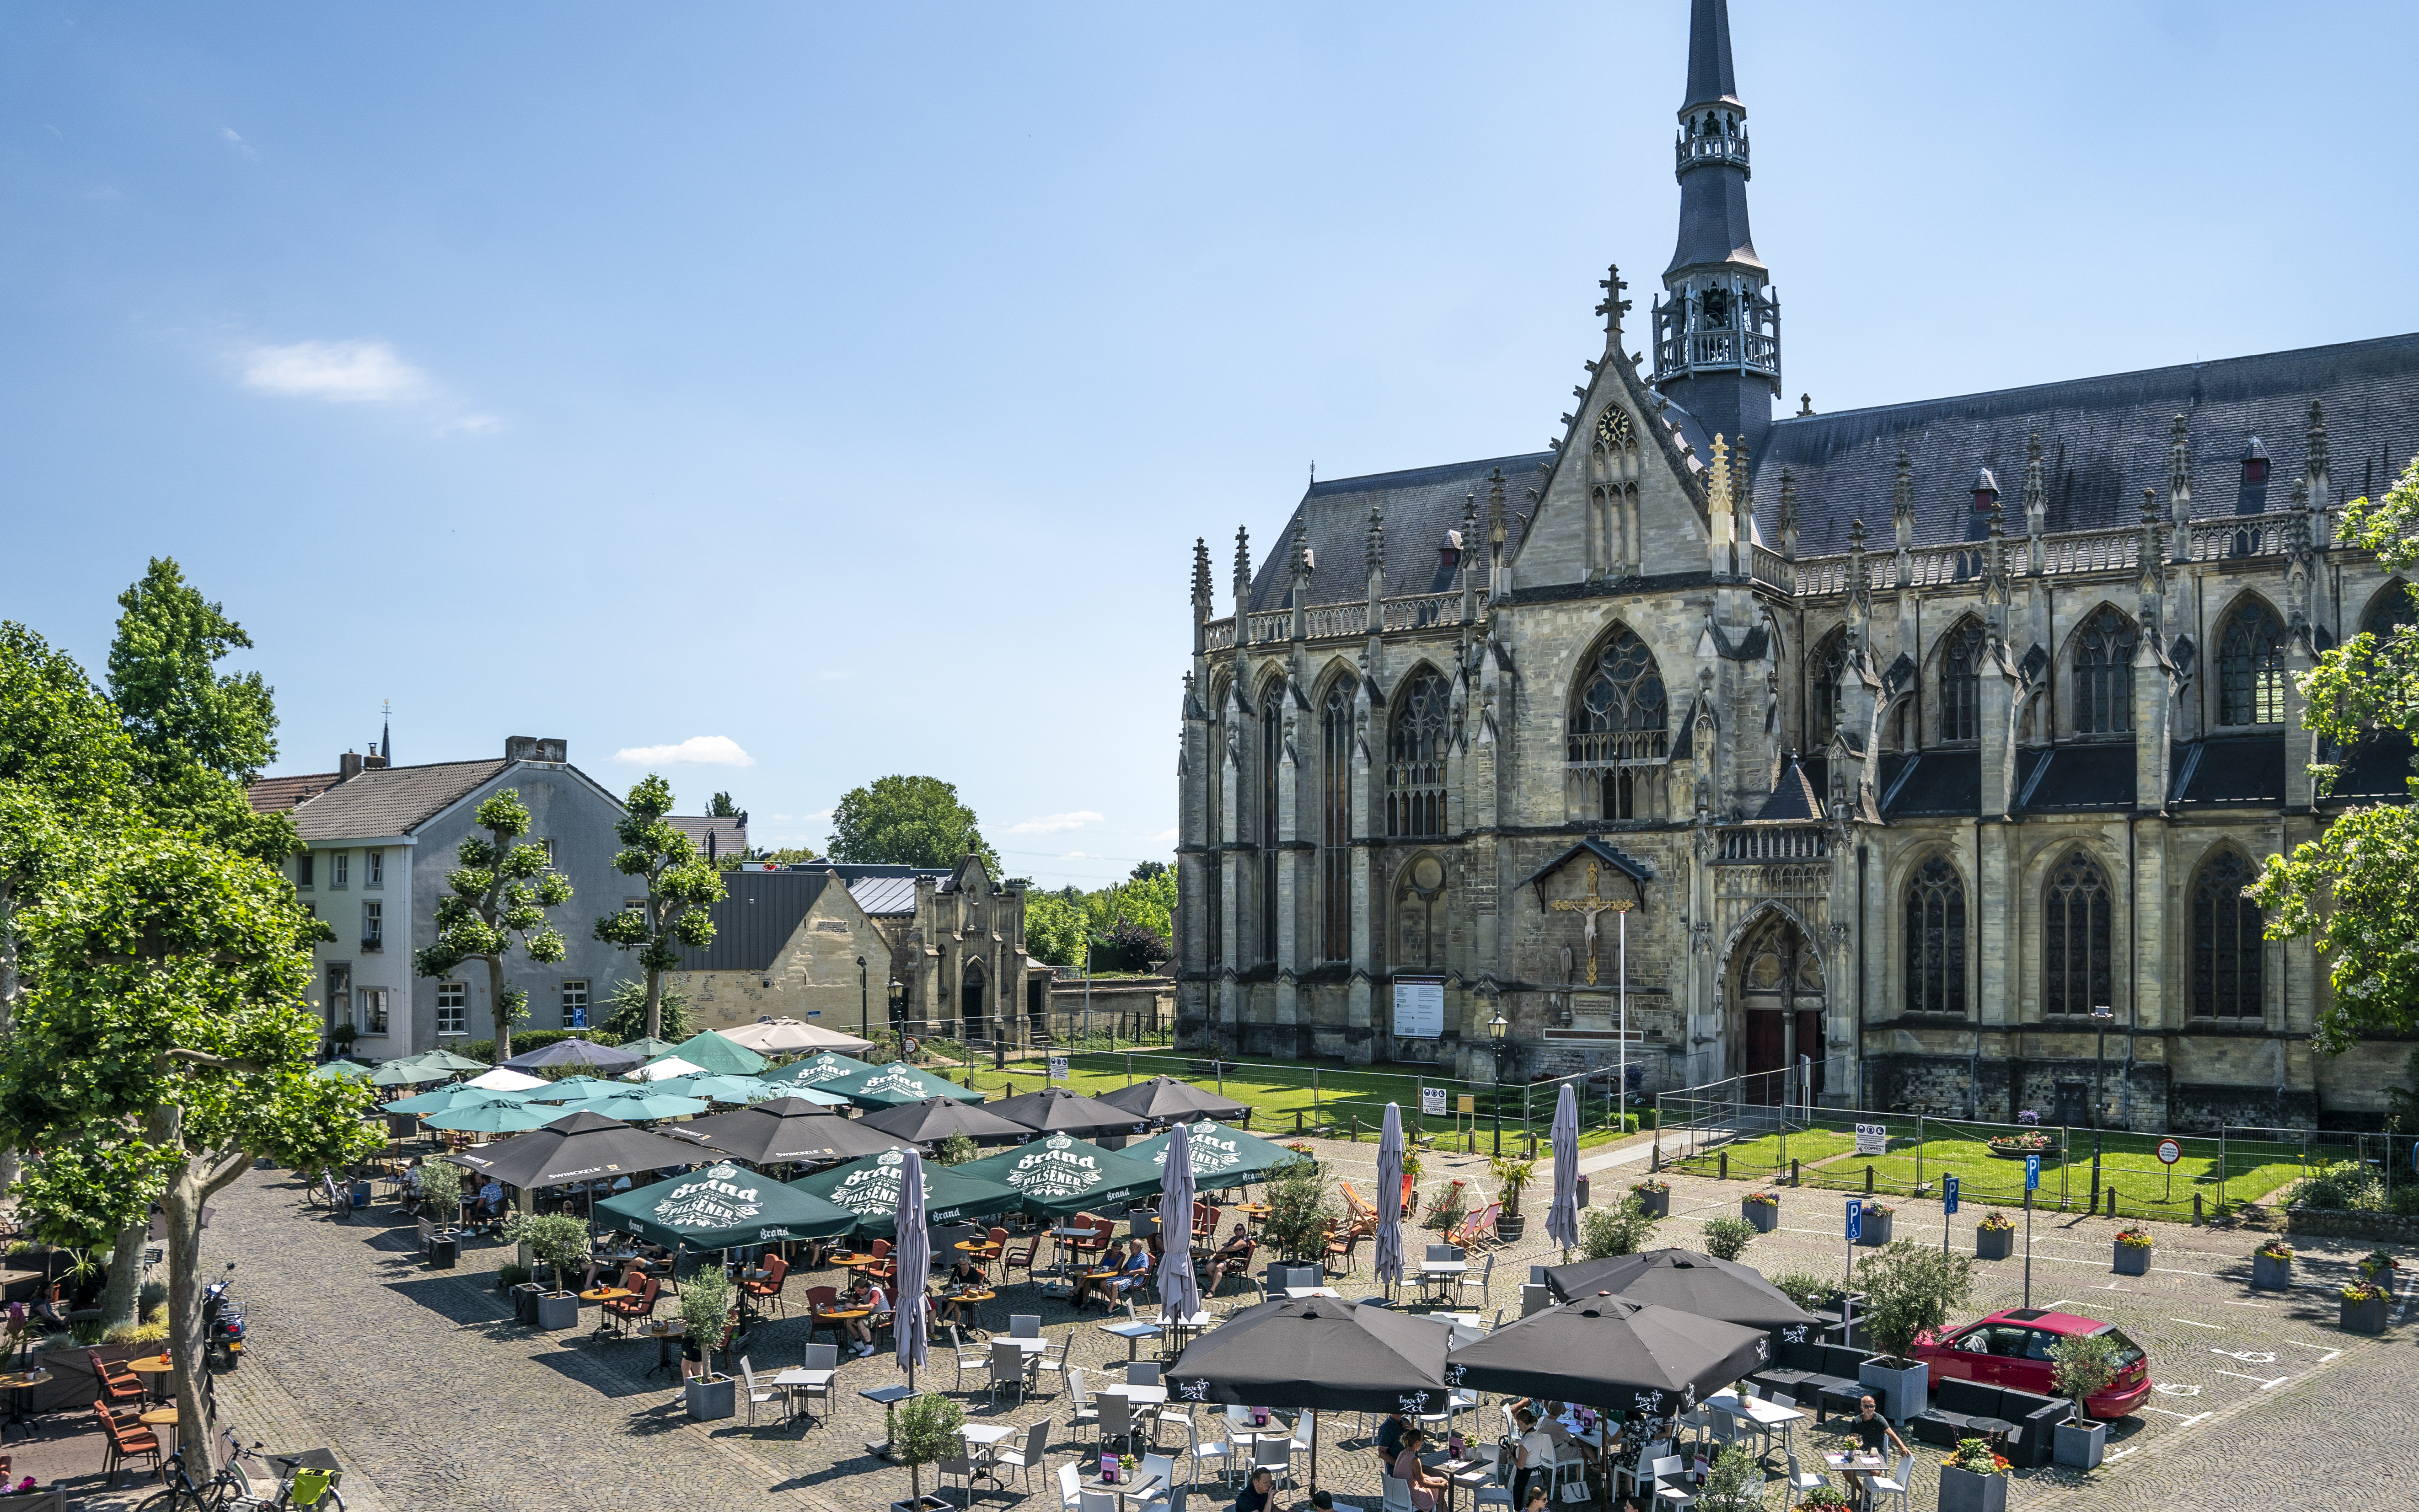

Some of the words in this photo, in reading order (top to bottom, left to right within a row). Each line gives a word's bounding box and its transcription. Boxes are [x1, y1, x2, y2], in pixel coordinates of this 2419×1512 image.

[576, 1010, 582, 1019] P
[798, 1064, 851, 1078] Brand
[866, 1073, 923, 1090] Brand
[1017, 1150, 1096, 1169] Brand
[2029, 1159, 2036, 1175] P
[1022, 1169, 1082, 1187] PILSENER
[670, 1179, 758, 1202] Brand
[844, 1186, 900, 1205] PILSENE
[1107, 1188, 1130, 1201] Brand
[1949, 1181, 1956, 1199] P
[667, 1199, 734, 1219] PILSENER
[933, 1207, 960, 1222] Brand
[1850, 1204, 1858, 1223] P
[629, 1219, 643, 1233] Brand
[760, 1227, 789, 1239] Brand
